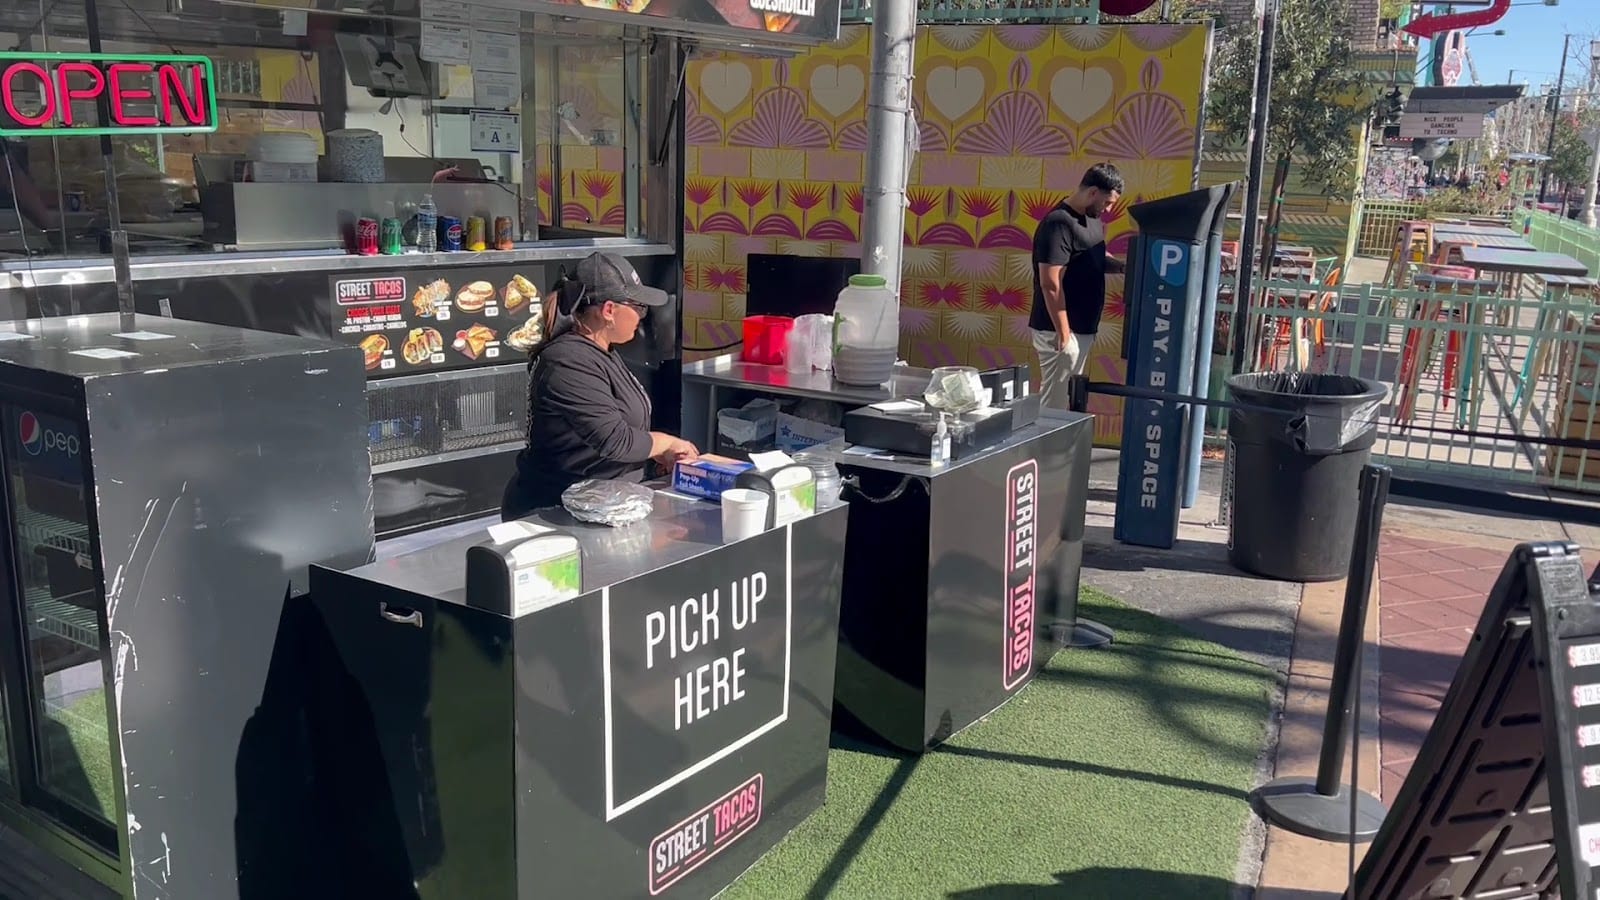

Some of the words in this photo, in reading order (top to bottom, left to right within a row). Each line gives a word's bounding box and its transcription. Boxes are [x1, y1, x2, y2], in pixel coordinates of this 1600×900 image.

[1, 62, 206, 127] OPEN
[491, 131, 501, 143] A
[340, 282, 372, 298] STREET
[373, 280, 402, 295] TACOS
[1160, 244, 1183, 277] P
[1153, 298, 1172, 363] PAY
[1148, 371, 1166, 407] B
[44, 429, 81, 458] pep
[1140, 424, 1162, 509] SPACE
[1015, 472, 1034, 569] STREET
[645, 587, 720, 669] PICK
[731, 571, 767, 630] UP
[1013, 575, 1033, 670] TACOS
[674, 647, 746, 731] HERE
[655, 814, 709, 875] STREET
[713, 782, 757, 837] TACOS
